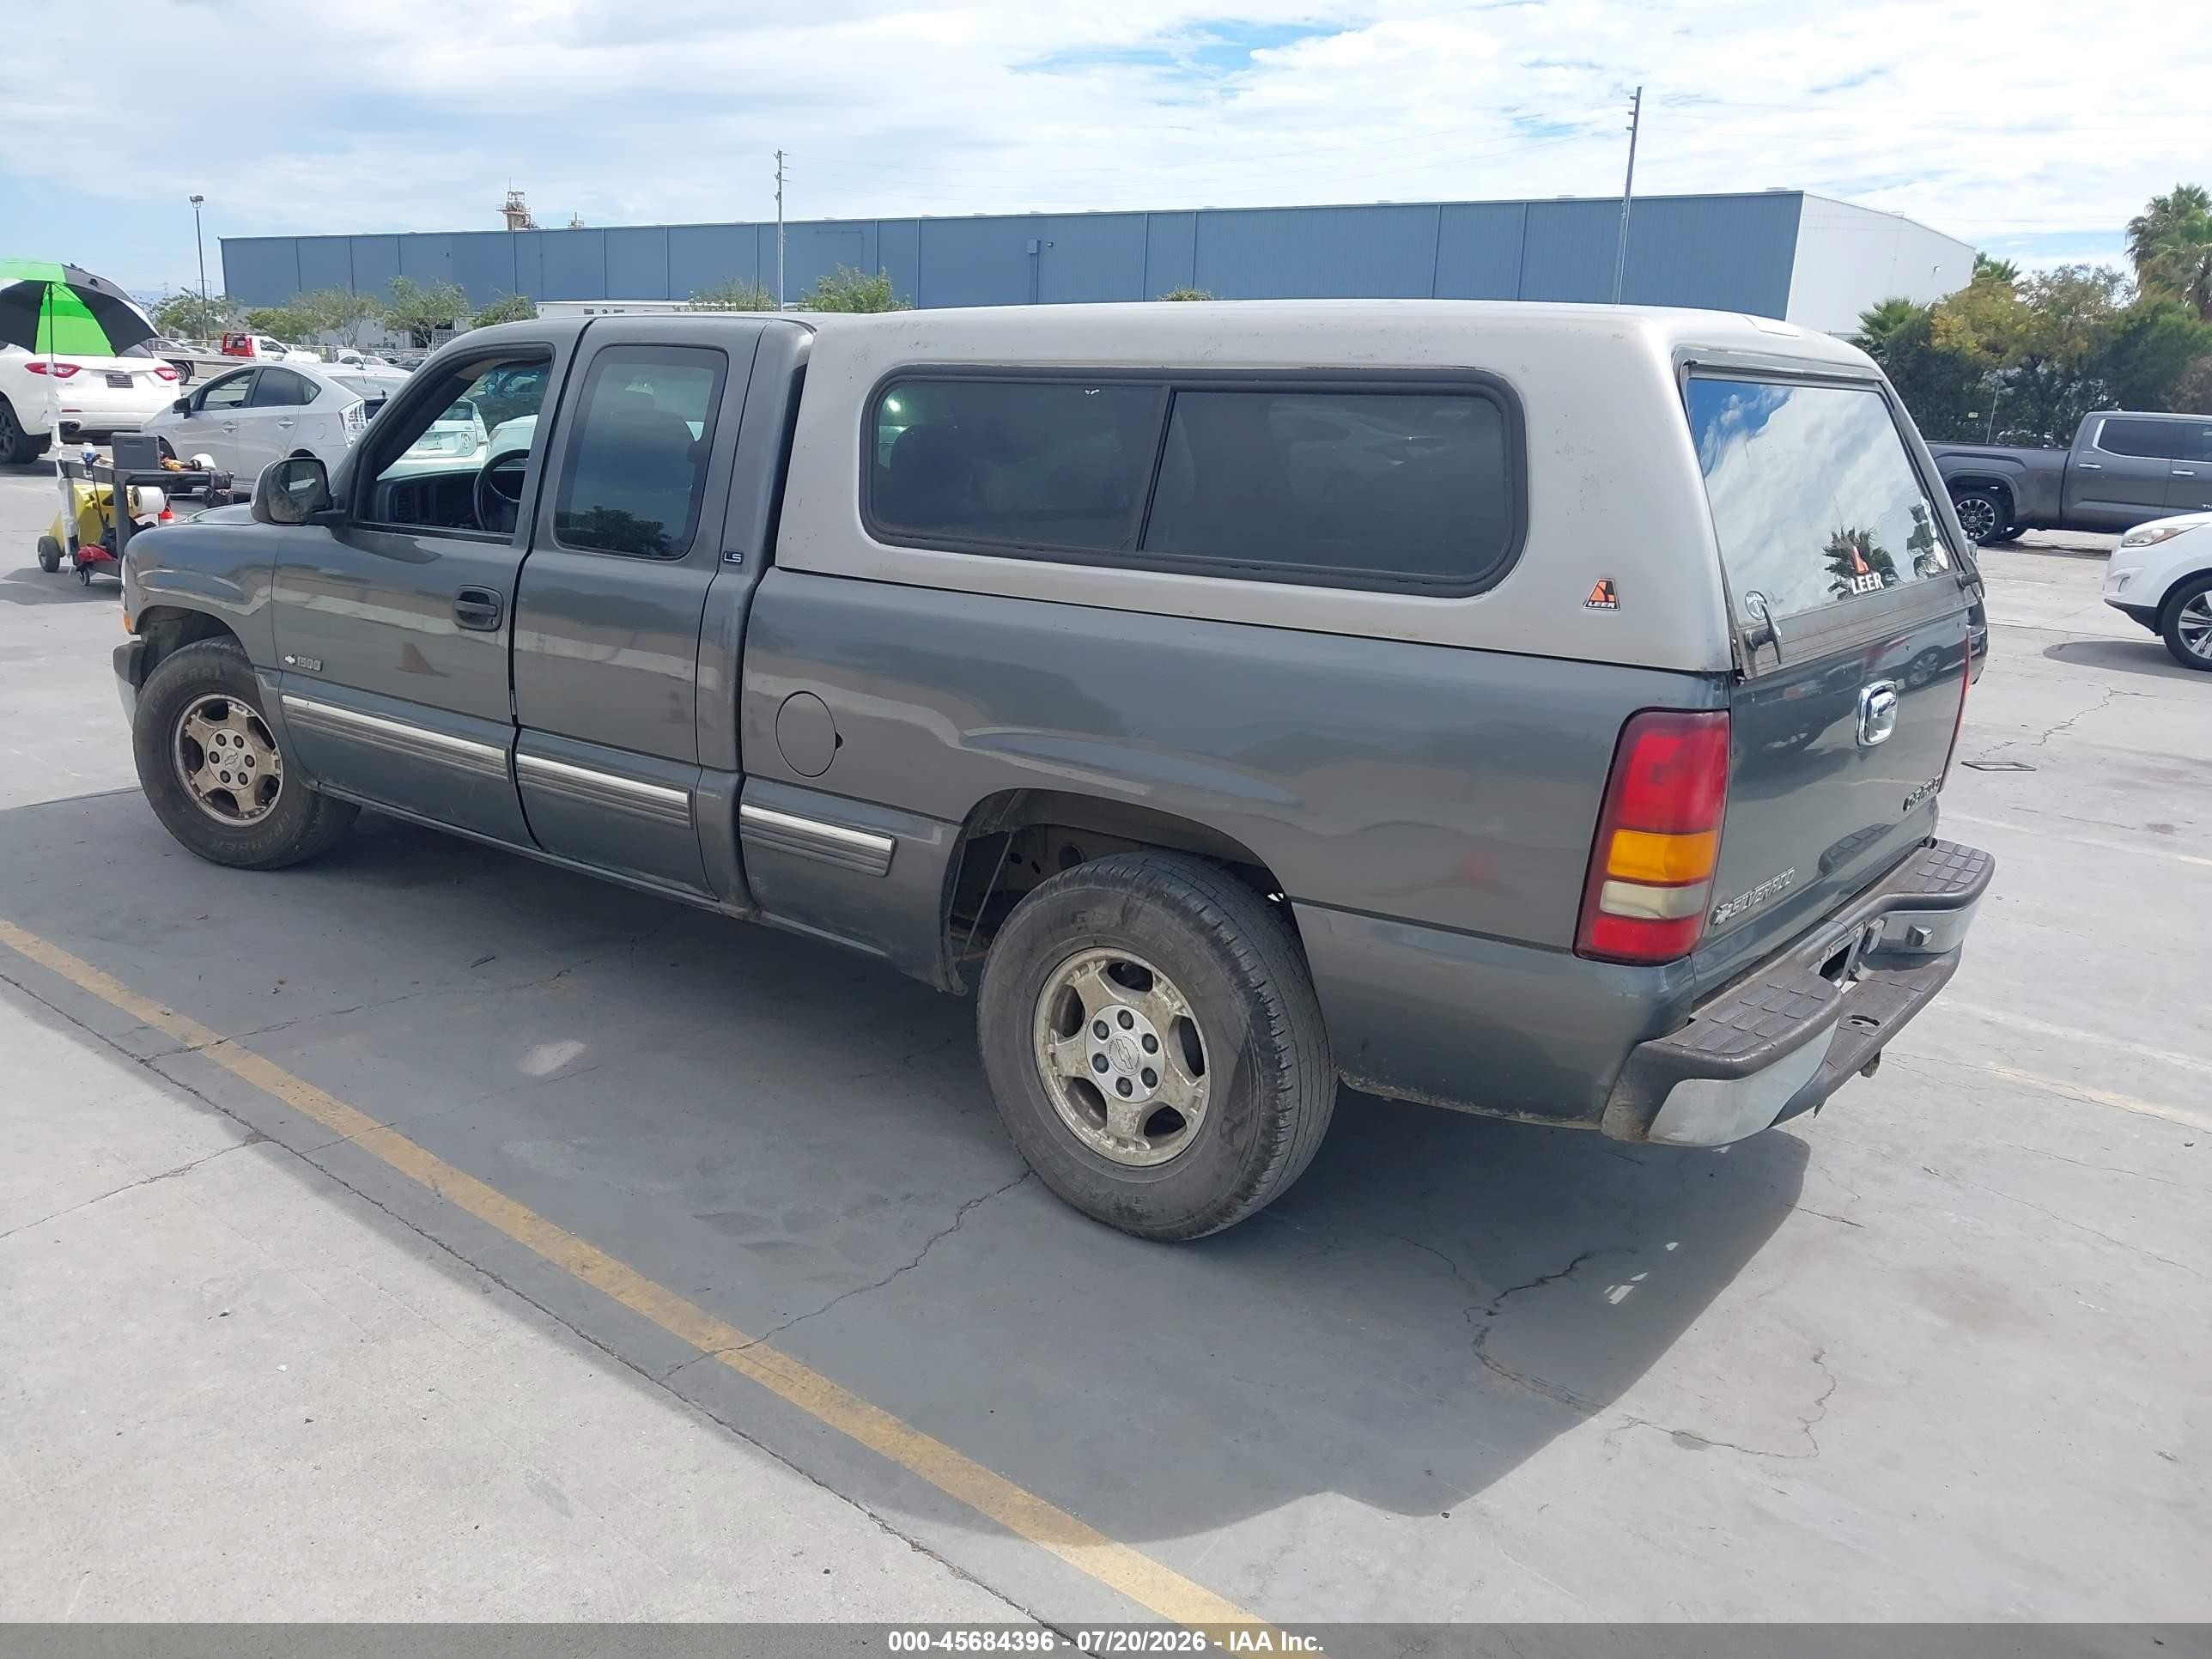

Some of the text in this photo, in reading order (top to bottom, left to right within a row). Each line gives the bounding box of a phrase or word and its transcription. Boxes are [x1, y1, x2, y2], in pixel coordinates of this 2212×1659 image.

[724, 552, 742, 562] LS
[1850, 571, 1885, 595] LEER
[296, 655, 323, 672] 1500
[1729, 866, 1796, 918] SILVERADO
